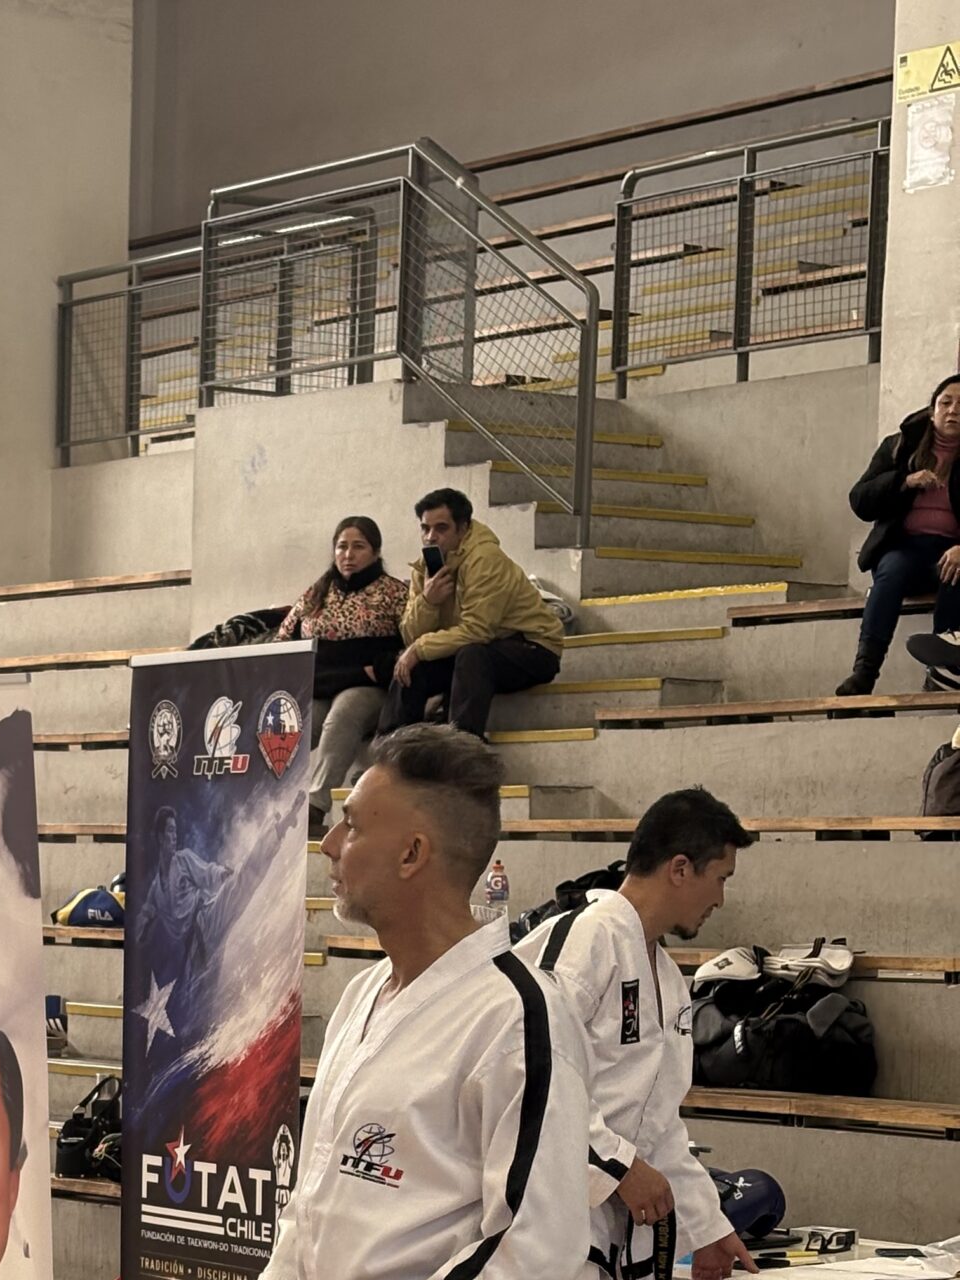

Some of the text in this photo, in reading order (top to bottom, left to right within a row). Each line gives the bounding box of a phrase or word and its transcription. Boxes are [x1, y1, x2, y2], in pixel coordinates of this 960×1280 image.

[193, 754, 250, 776] ITFU
[87, 908, 114, 921] FILA
[141, 1153, 272, 1216] FUTAT
[226, 1217, 272, 1243] CHILE
[141, 1229, 272, 1260] FUNDACIÓN DE TAEKWON-DO TRADICIONAL
[141, 1257, 185, 1276] TRADICIÓN
